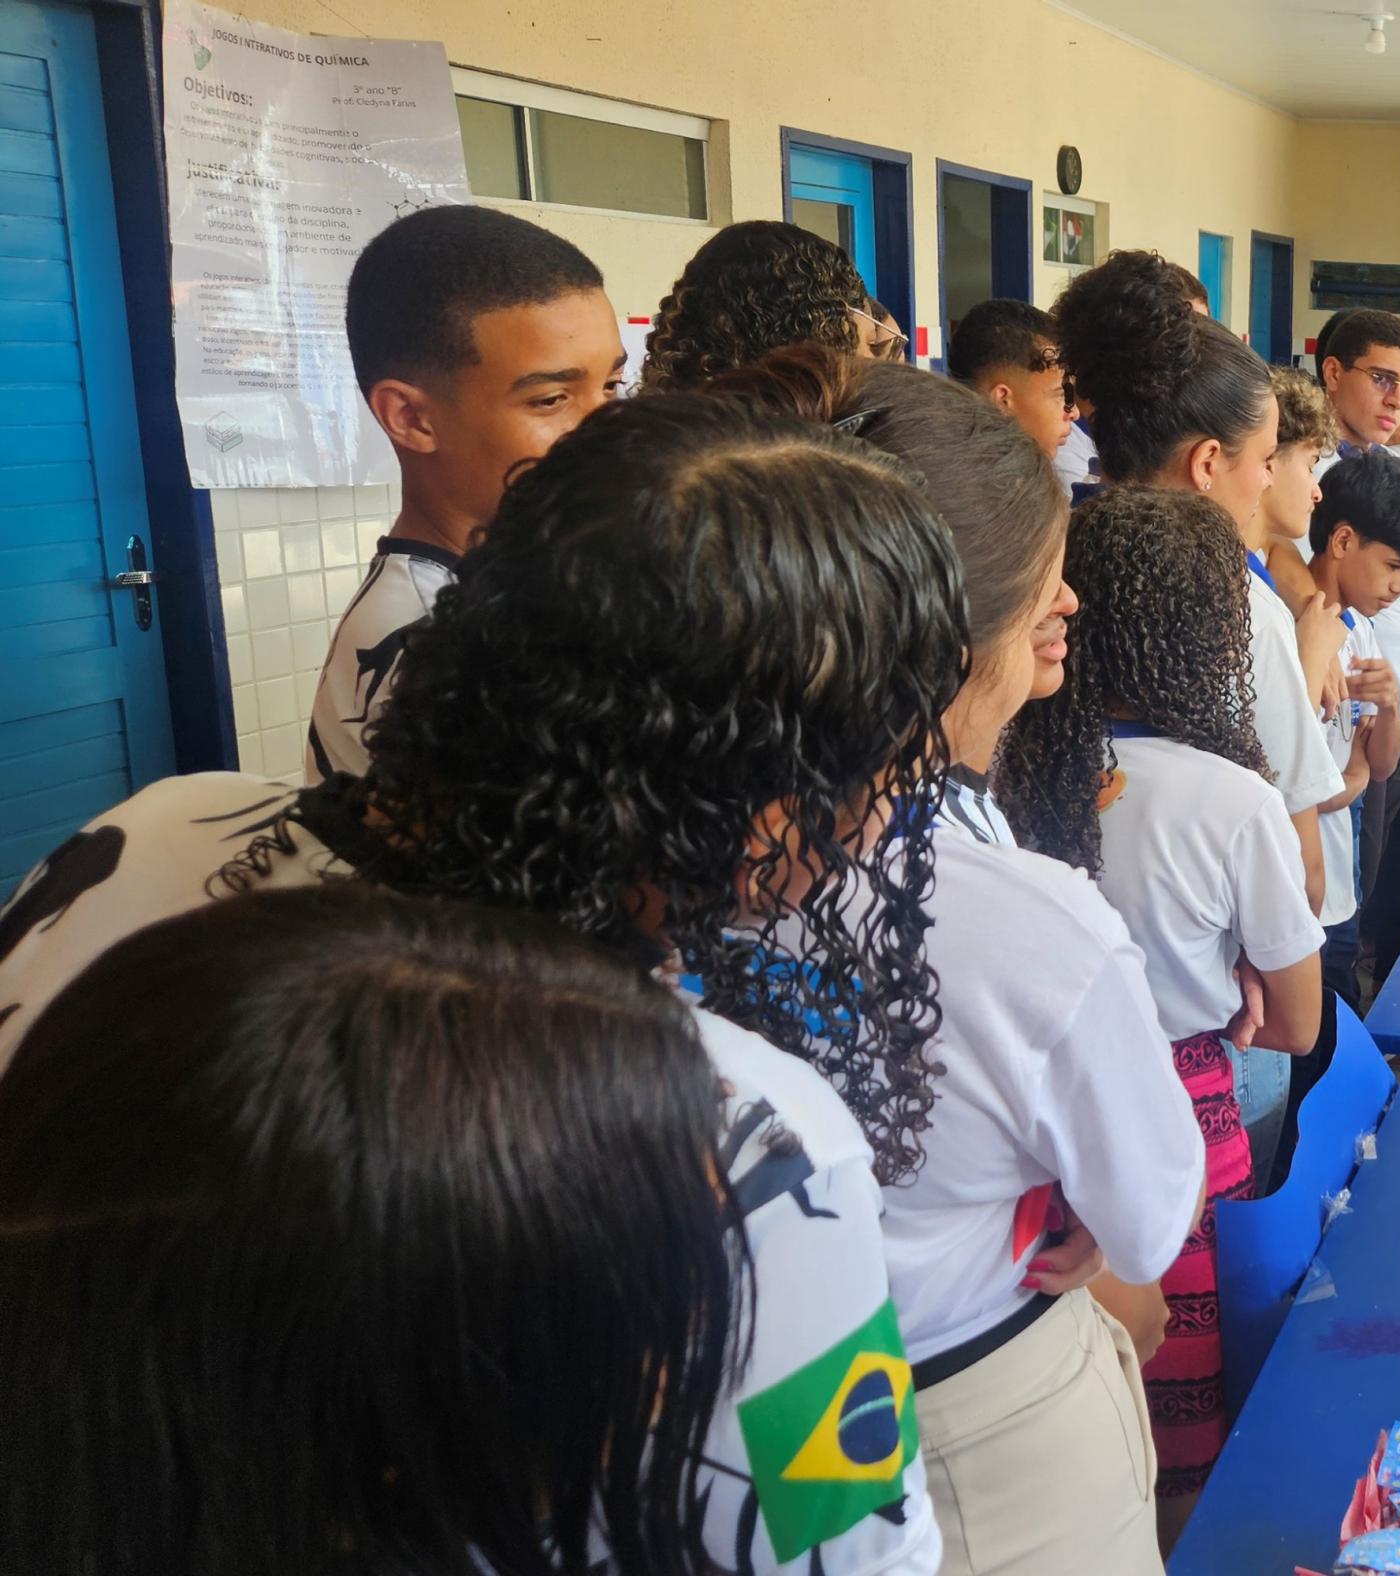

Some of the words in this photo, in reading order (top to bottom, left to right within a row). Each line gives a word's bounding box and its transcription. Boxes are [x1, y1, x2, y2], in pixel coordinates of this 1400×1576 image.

[212, 28, 238, 45] JOGOS
[298, 53, 312, 64] DE
[315, 53, 370, 67] QUÍMICA
[366, 87, 385, 95] ano
[302, 202, 353, 215] inovadora
